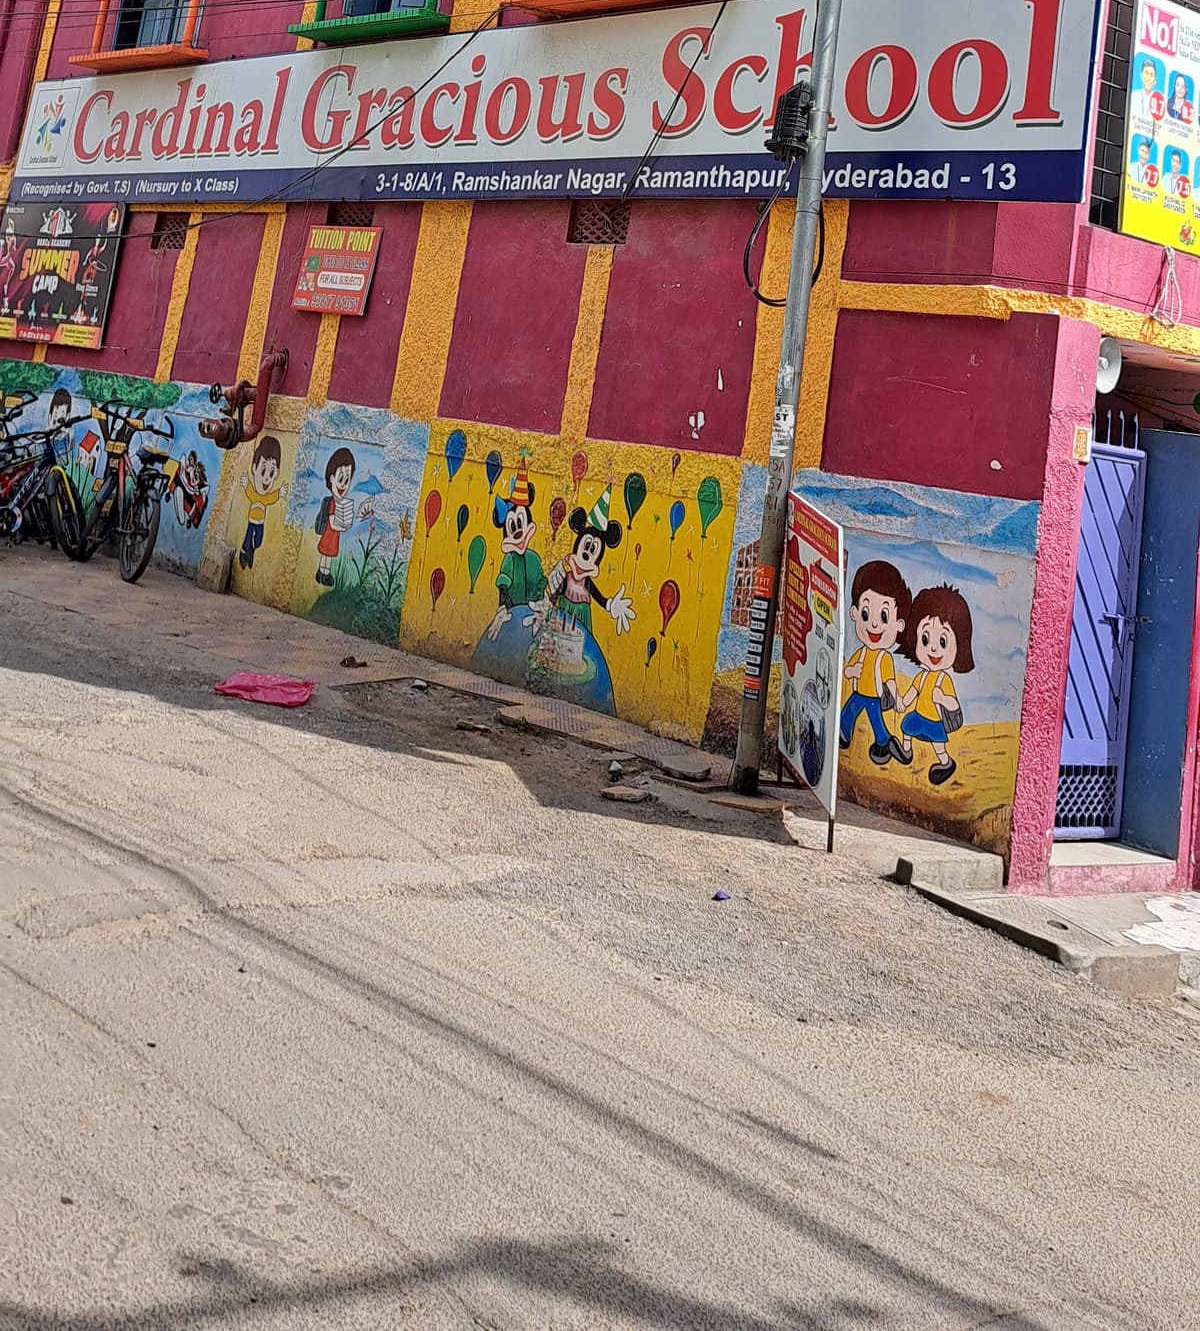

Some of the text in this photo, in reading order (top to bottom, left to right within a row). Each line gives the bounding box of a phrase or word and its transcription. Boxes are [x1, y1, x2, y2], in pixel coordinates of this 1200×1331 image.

[1141, 3, 1179, 53] No.1
[73, 65, 292, 161] Cardinal
[301, 54, 630, 151] Gracious
[21, 181, 72, 197] (Recognised
[73, 181, 85, 195] by
[86, 180, 110, 194] Govt.
[114, 179, 131, 195] T.S)
[135, 179, 179, 196] (Nursury
[181, 179, 192, 192] to
[194, 178, 204, 192] X
[204, 177, 239, 194] Class)
[376, 171, 447, 194] 3-1-8/A/1,
[451, 169, 561, 192] Ramshankar
[566, 167, 628, 195] Nagar,
[633, 164, 791, 195] Ramanthapur,
[819, 163, 950, 195] yderabad
[980, 162, 1017, 191] 13
[310, 228, 376, 253] TUITION POINT
[19, 249, 80, 285] SUMMER
[31, 274, 59, 295] CAMP
[816, 597, 831, 617] OPEN
